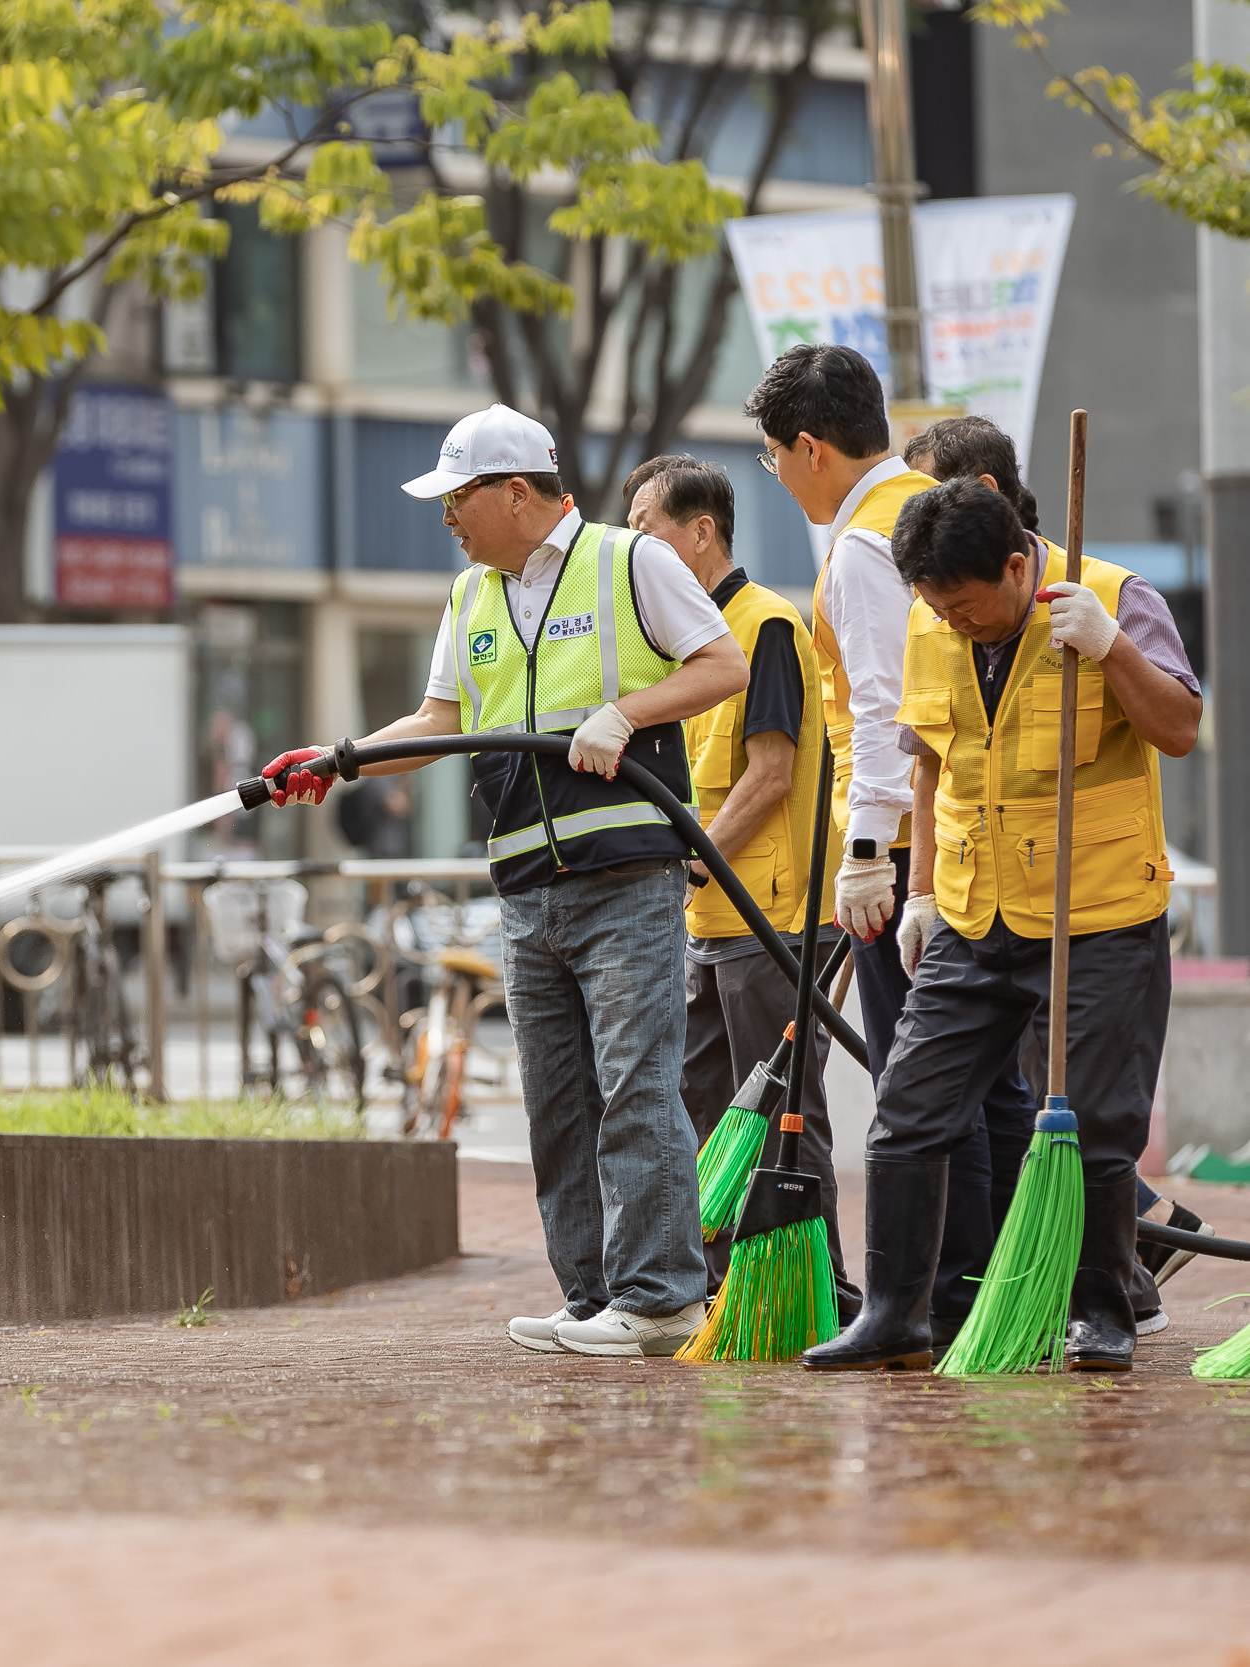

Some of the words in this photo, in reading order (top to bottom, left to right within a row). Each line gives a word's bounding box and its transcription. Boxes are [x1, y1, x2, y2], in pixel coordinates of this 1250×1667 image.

[475, 460, 501, 470] PRO
[505, 459, 519, 467] V1
[473, 652, 494, 662] 광진구
